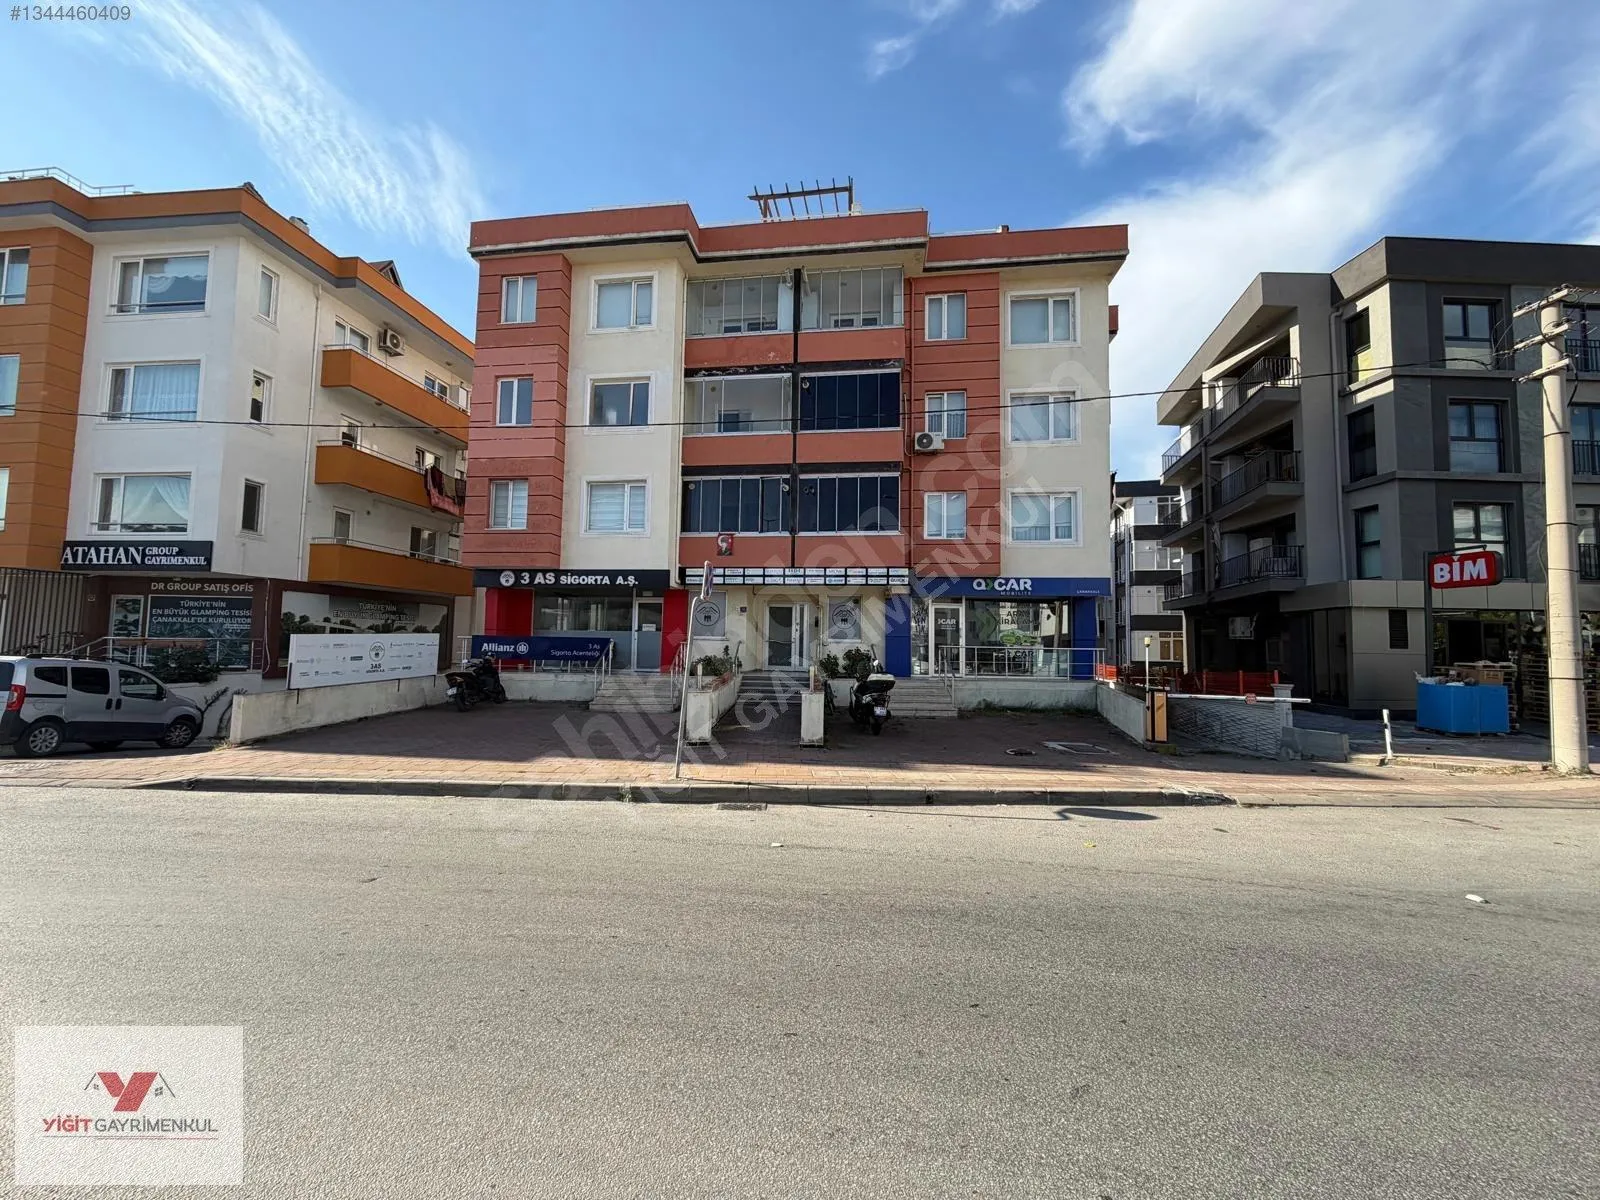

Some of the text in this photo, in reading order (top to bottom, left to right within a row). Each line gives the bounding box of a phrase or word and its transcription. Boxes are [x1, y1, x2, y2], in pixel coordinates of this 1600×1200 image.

[61, 546, 179, 565] ATAHAN GROUP
[1433, 555, 1488, 583] BİM
[520, 572, 639, 587] 3 AS SİGORTA A.Ş.
[151, 582, 254, 593] DR GROUP SATIŞ OFİS
[180, 599, 227, 608] TÜRKİYE'NİN
[191, 608, 230, 616] GLAMPİNG
[481, 642, 515, 652] Allianz
